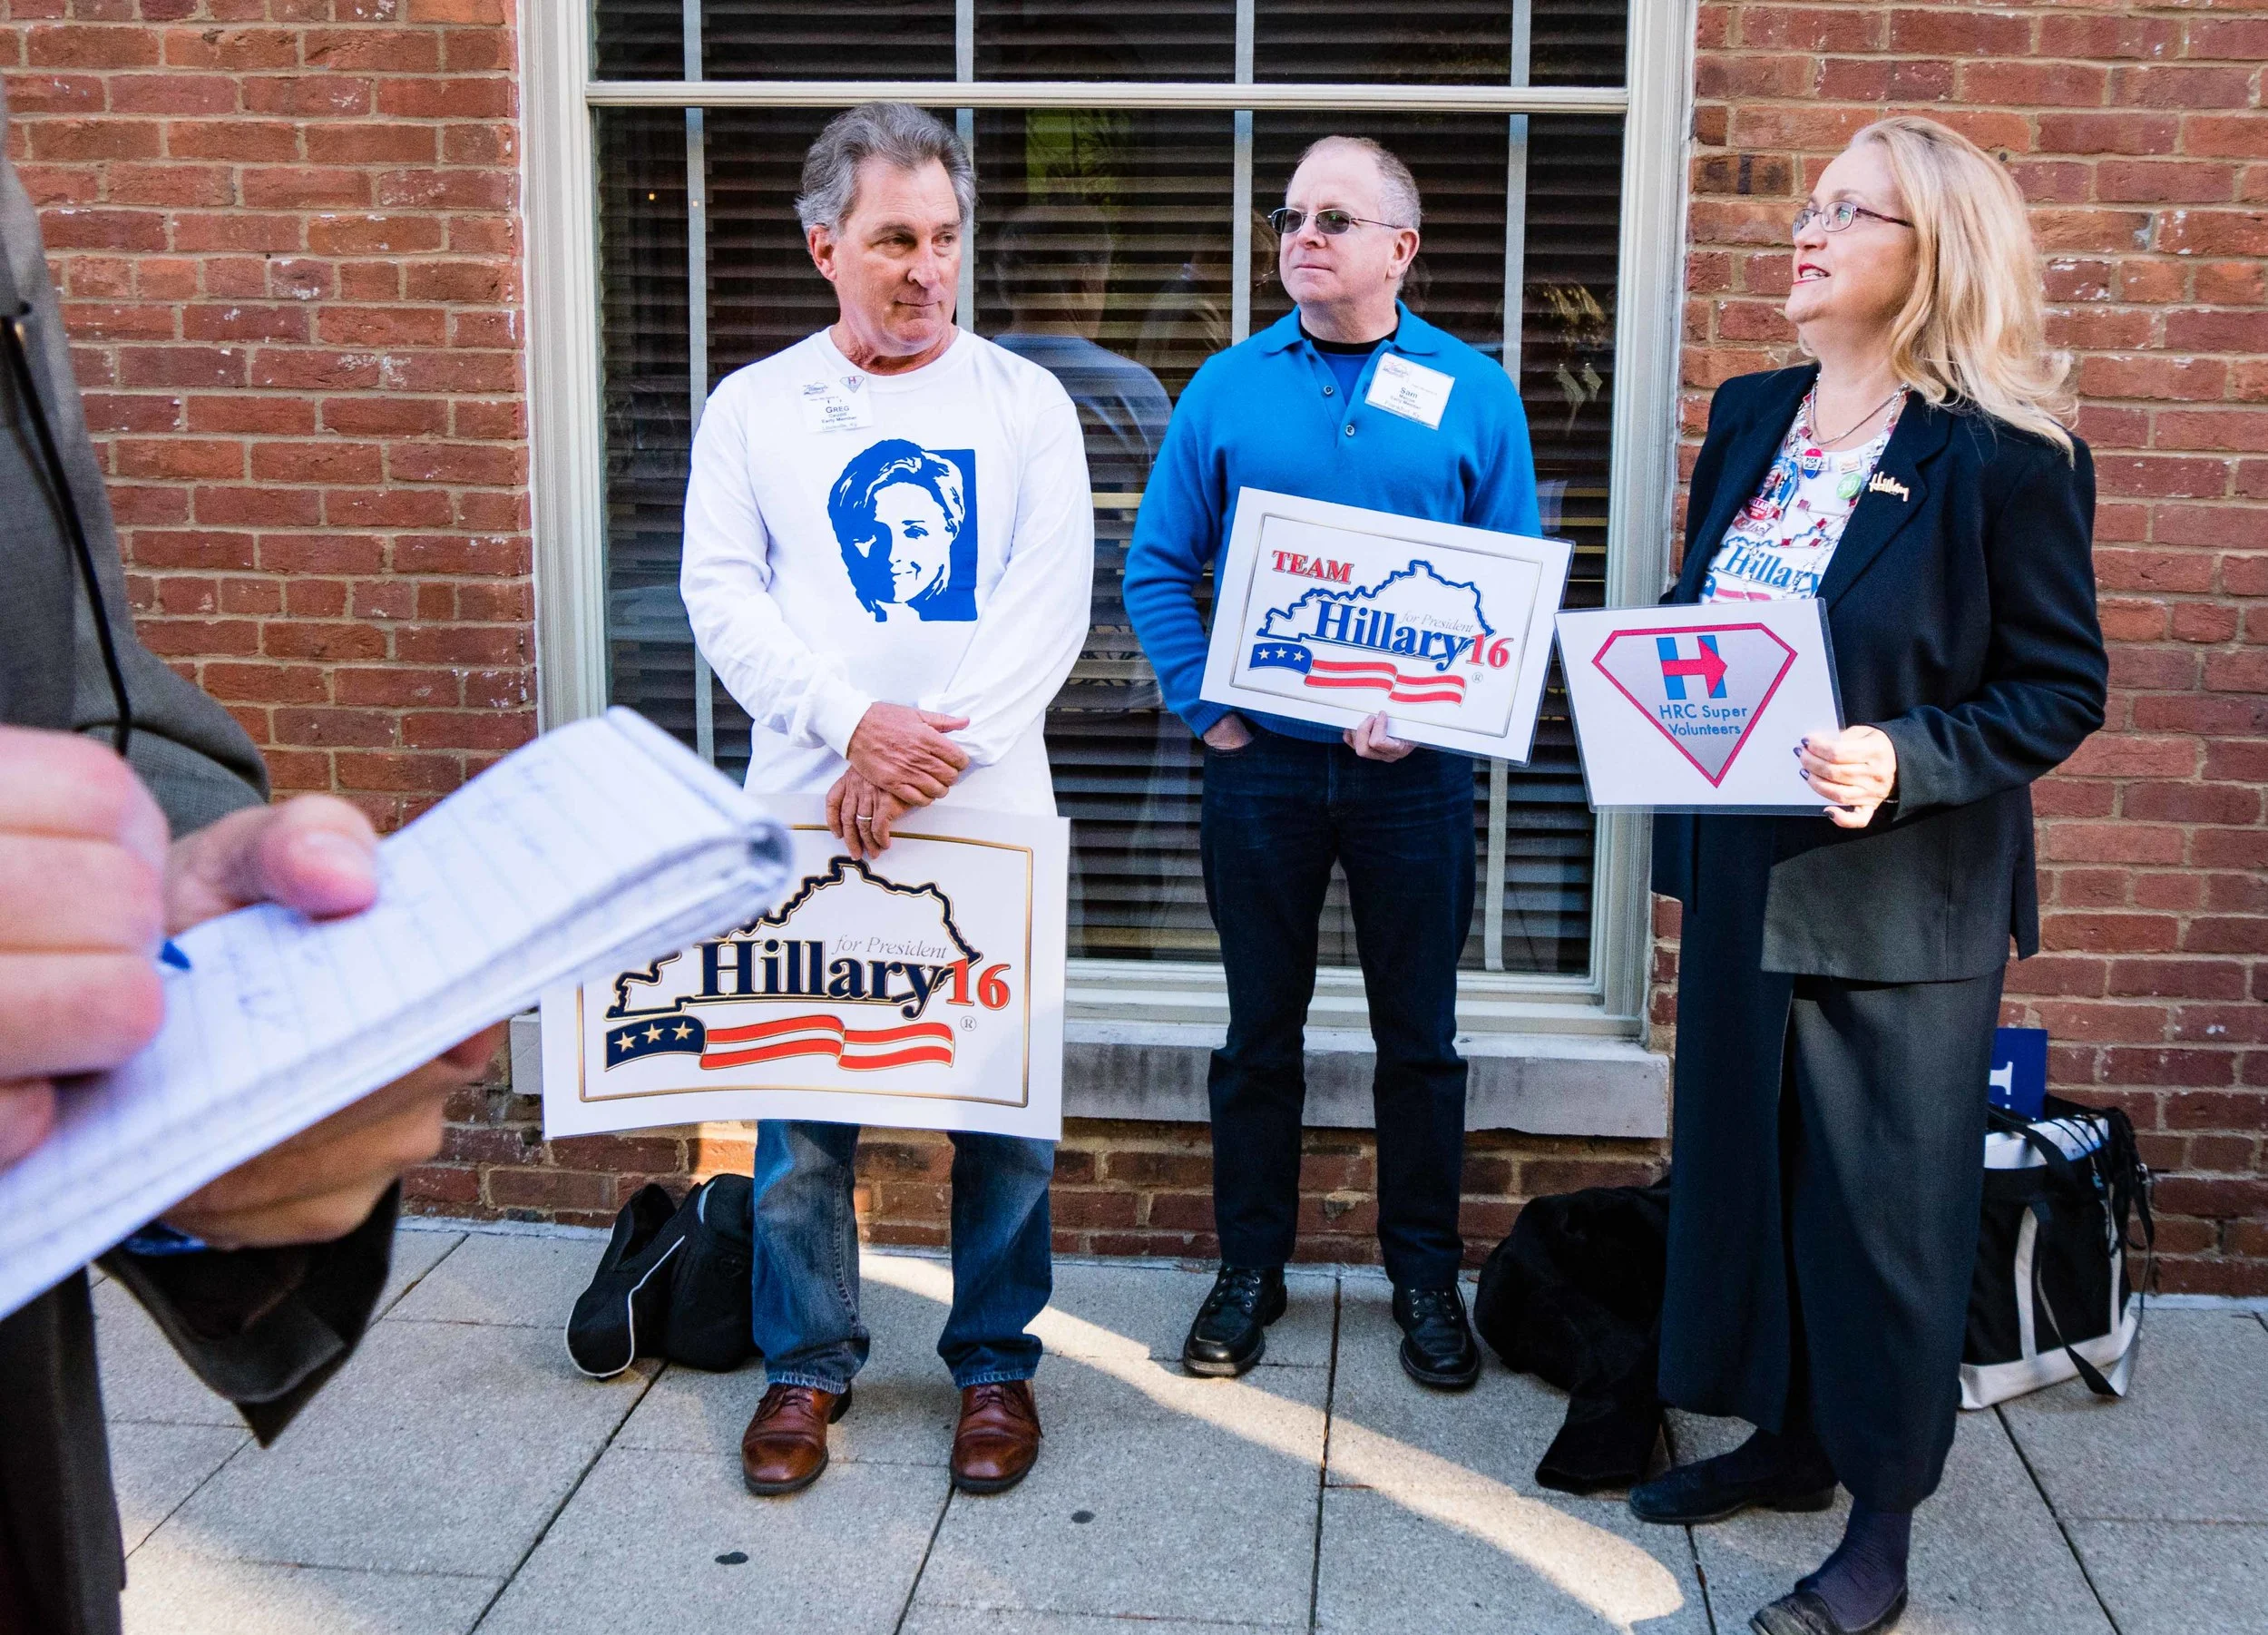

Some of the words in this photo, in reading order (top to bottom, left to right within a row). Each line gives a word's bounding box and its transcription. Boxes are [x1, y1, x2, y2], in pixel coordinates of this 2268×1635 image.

[1401, 387, 1418, 398] Sam
[826, 406, 849, 414] GREG
[1869, 471, 1910, 502] Hillary
[1272, 550, 1354, 584] TEAM
[1401, 611, 1420, 626] for
[1421, 613, 1474, 632] President
[1314, 599, 1468, 672] Hillary
[1465, 632, 1514, 671] 16
[1659, 704, 1696, 719] HRC
[1702, 705, 1748, 720] Super
[1667, 722, 1740, 737] Volunteers
[833, 934, 863, 956] for
[865, 935, 948, 960] President
[694, 937, 948, 1021] Hillary
[945, 957, 1012, 1012] 16
